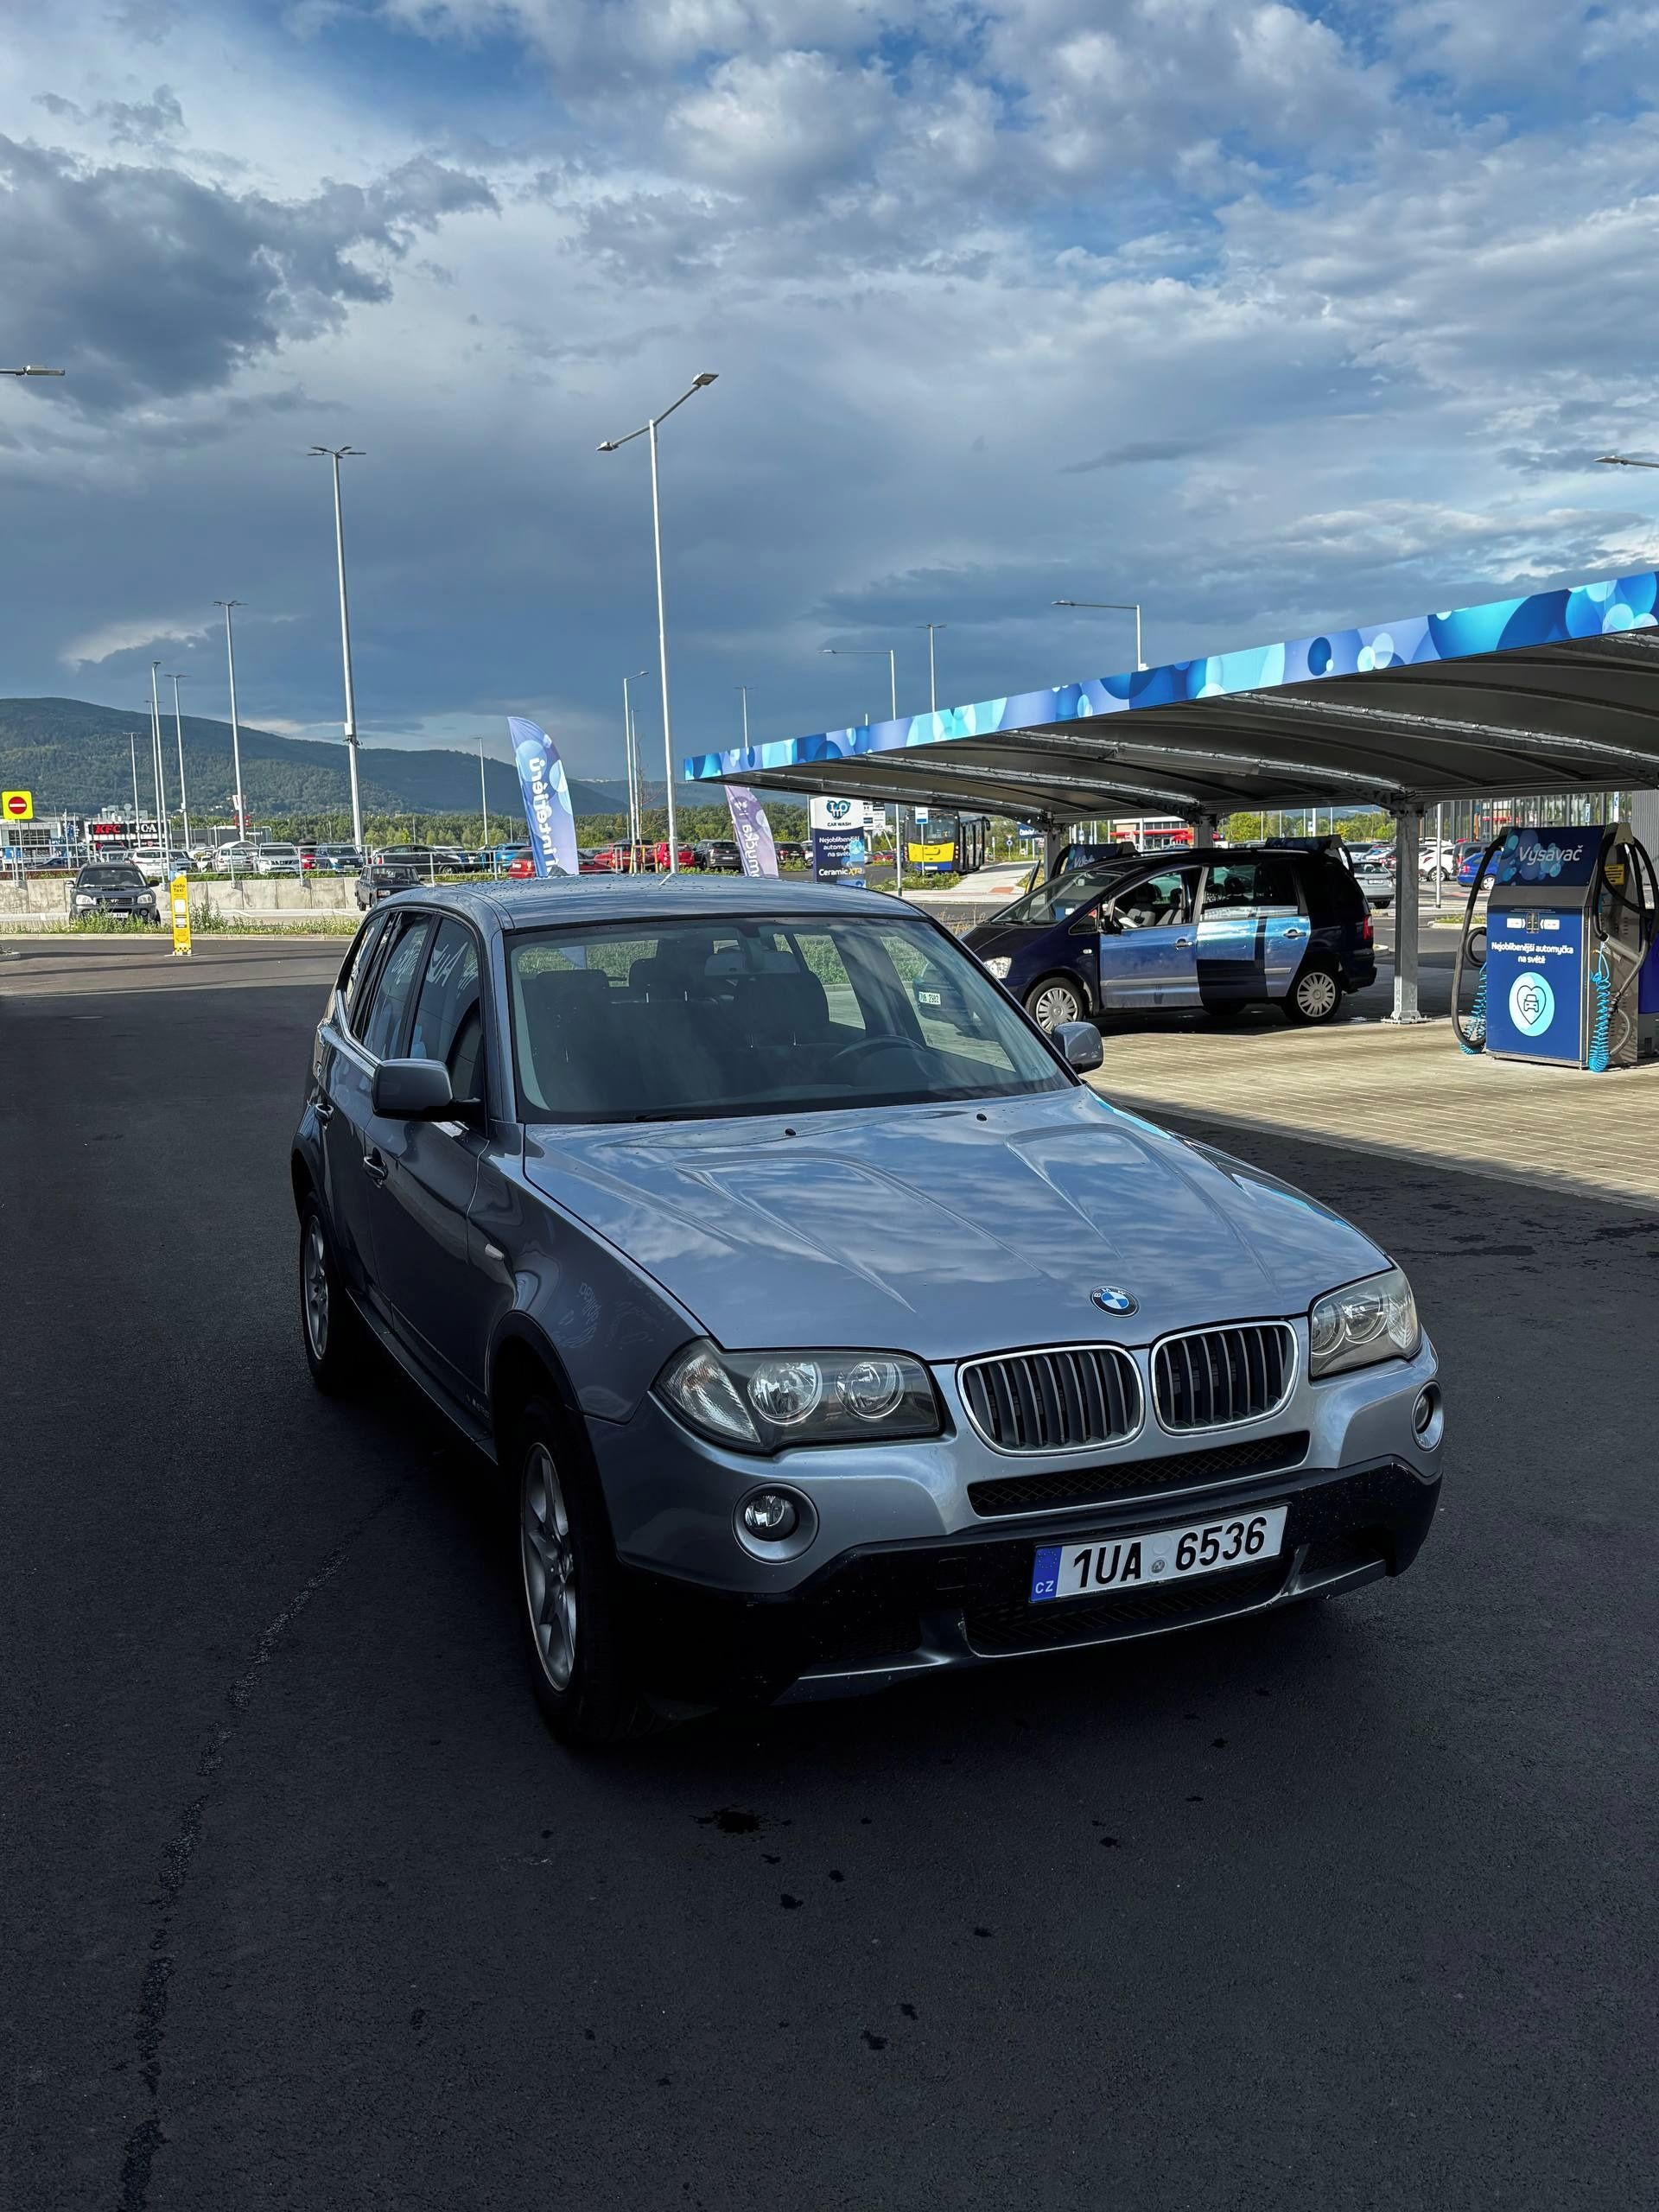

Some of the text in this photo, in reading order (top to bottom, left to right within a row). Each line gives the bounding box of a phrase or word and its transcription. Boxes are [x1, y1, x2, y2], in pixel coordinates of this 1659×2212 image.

[95, 824, 121, 834] KFC
[1519, 844, 1584, 866] Vysavač
[818, 868, 849, 876] Ceramic
[1535, 944, 1574, 955] automyčka
[1035, 1516, 1268, 1594] CZ 1UA 6536
